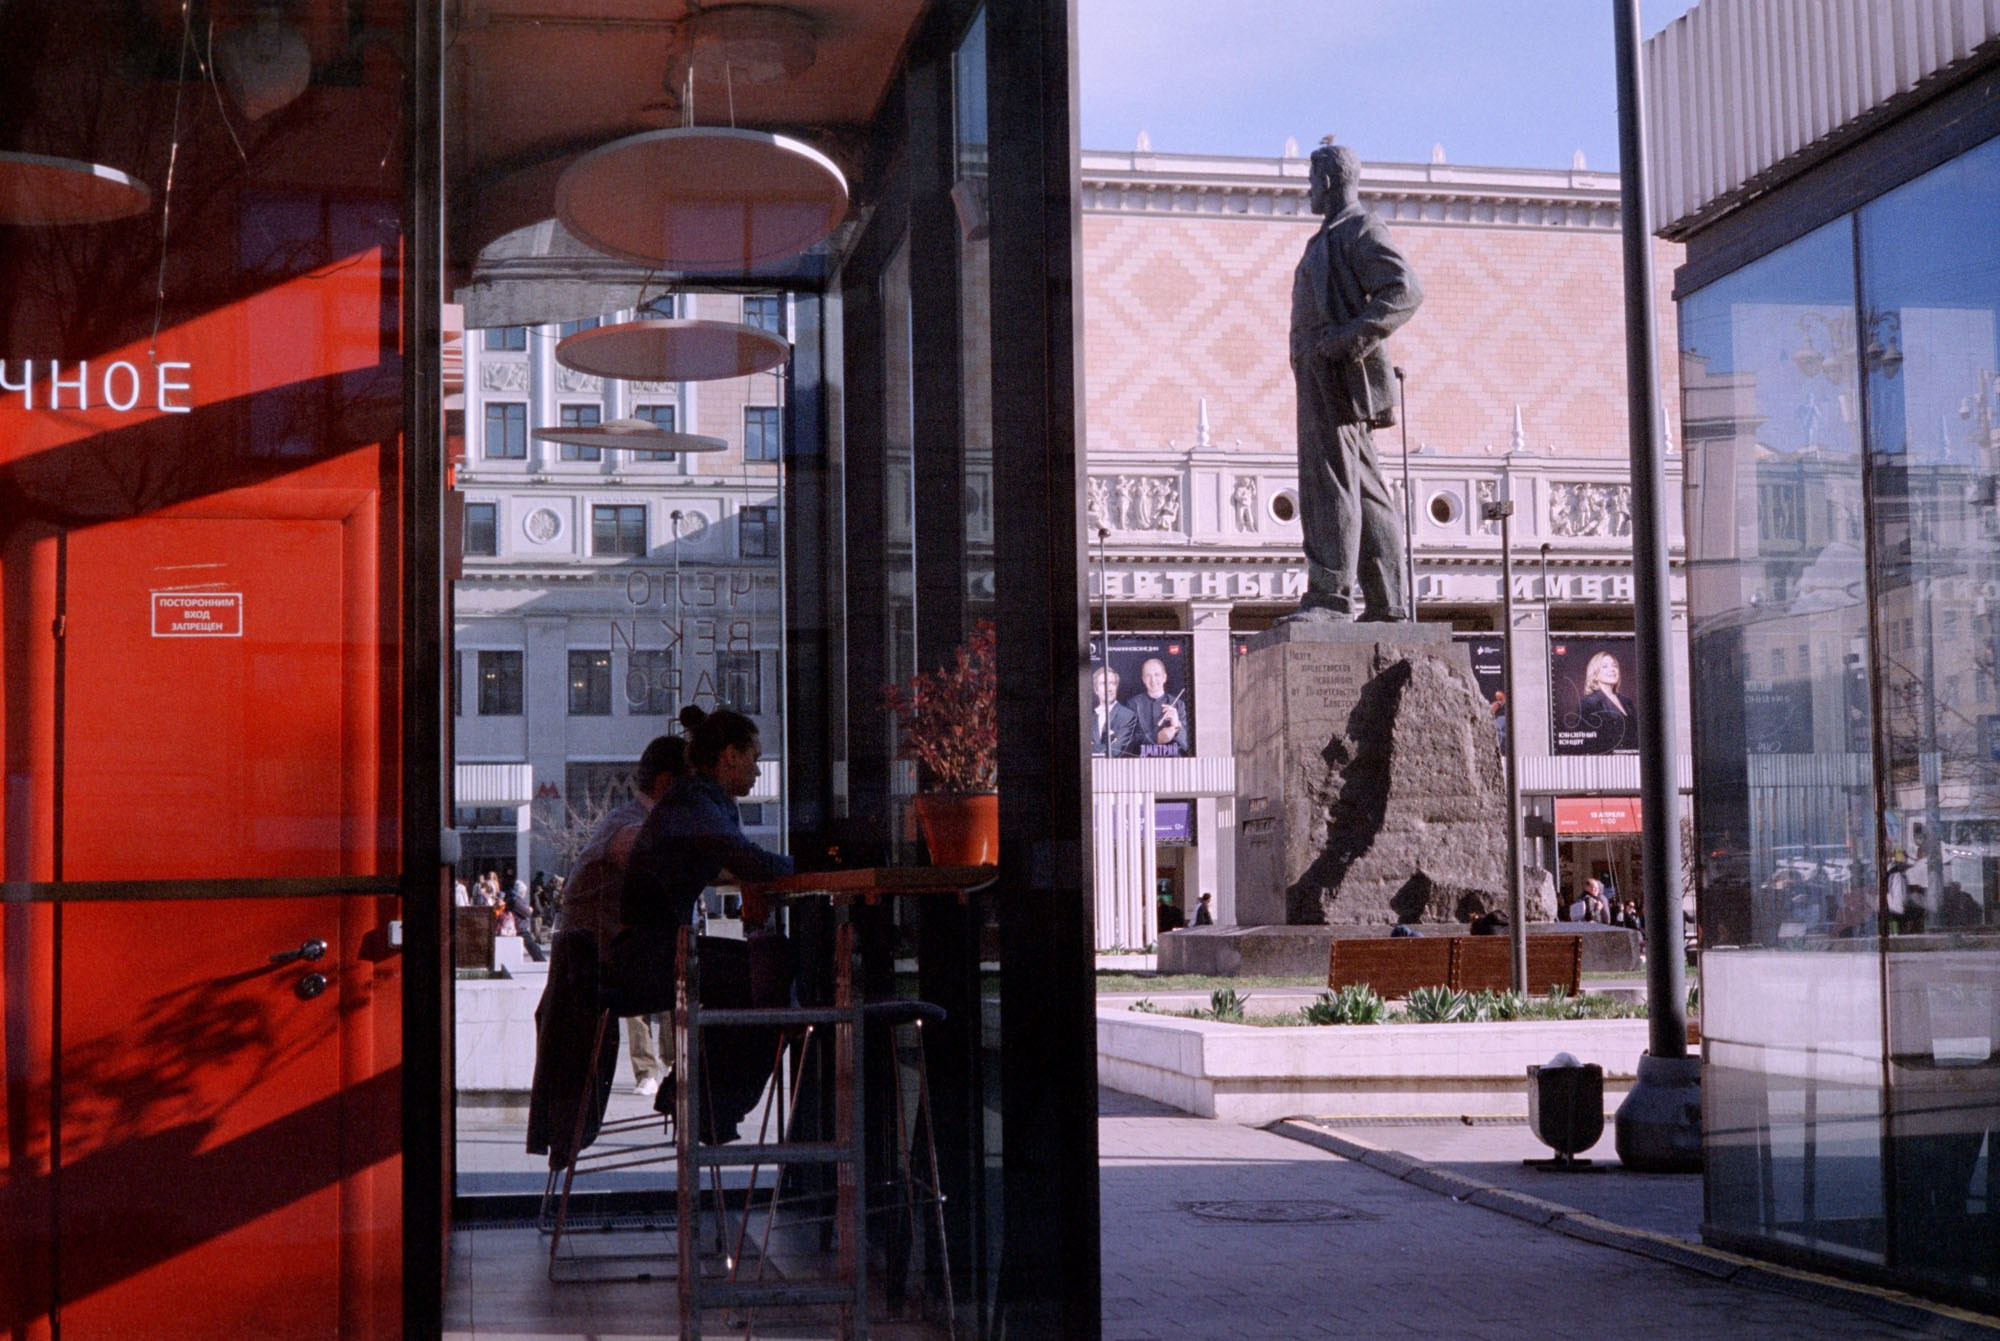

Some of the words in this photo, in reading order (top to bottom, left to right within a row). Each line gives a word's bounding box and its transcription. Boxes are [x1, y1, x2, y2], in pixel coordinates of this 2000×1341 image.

[0, 359, 191, 412] ЧНОЕ
[1099, 568, 1307, 597] ЕРТНЫЙ
[1509, 574, 1633, 598] ИМЕН
[160, 598, 234, 607] ПОСТОРОННИМ
[183, 610, 211, 620] ВХОД
[171, 622, 223, 632] ЗАПРЕЩЕН
[1140, 743, 1179, 757] ДМИТРИЙ
